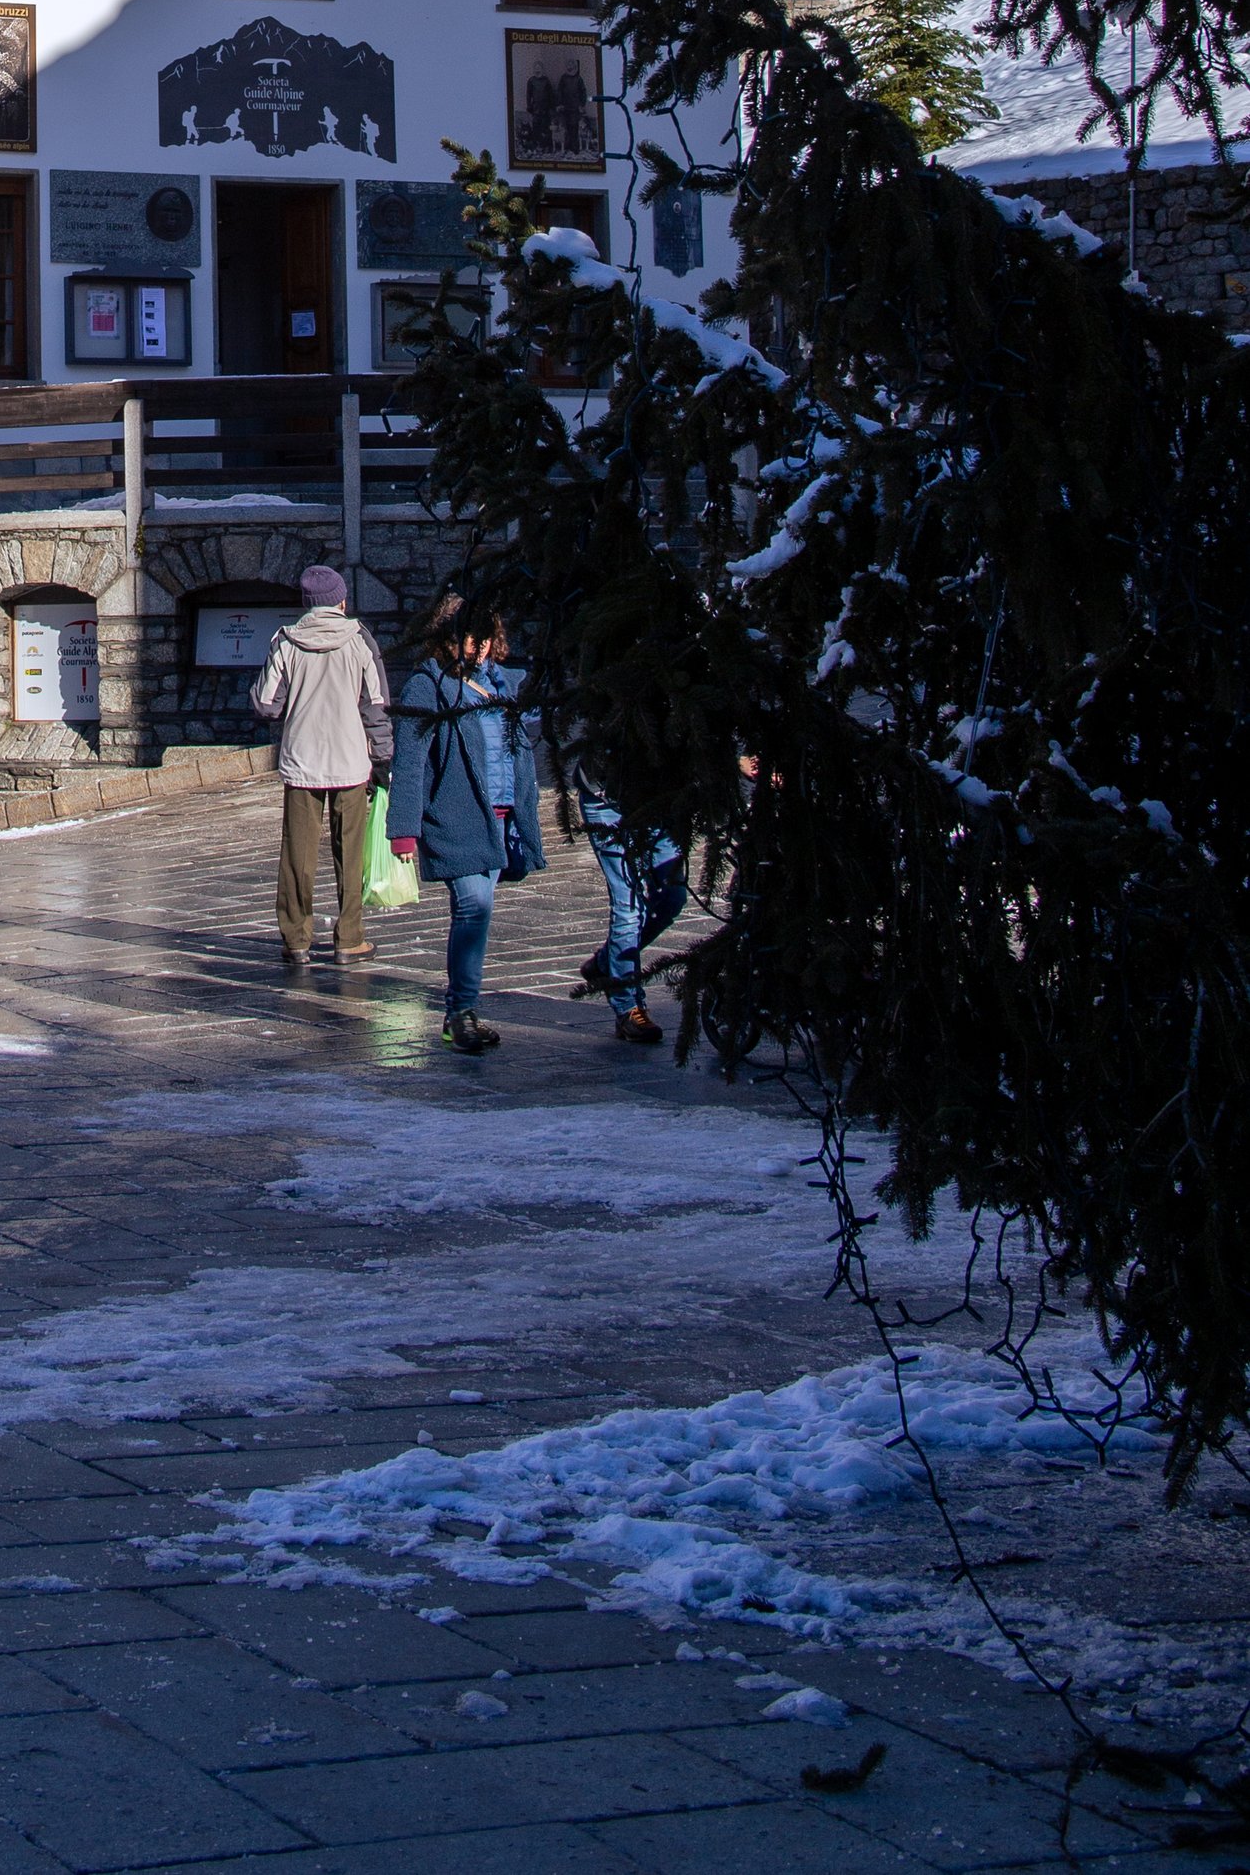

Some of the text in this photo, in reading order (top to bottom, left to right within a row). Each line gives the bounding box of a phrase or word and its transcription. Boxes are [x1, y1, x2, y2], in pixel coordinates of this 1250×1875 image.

[512, 32, 595, 45] Duca degli Abruzzi
[243, 86, 305, 103] Guide Alpine
[246, 99, 302, 114] Courmayeur
[12, 142, 30, 151] alpin
[268, 144, 286, 155] 1850
[57, 645, 83, 656] Guide
[76, 694, 94, 704] 1850
